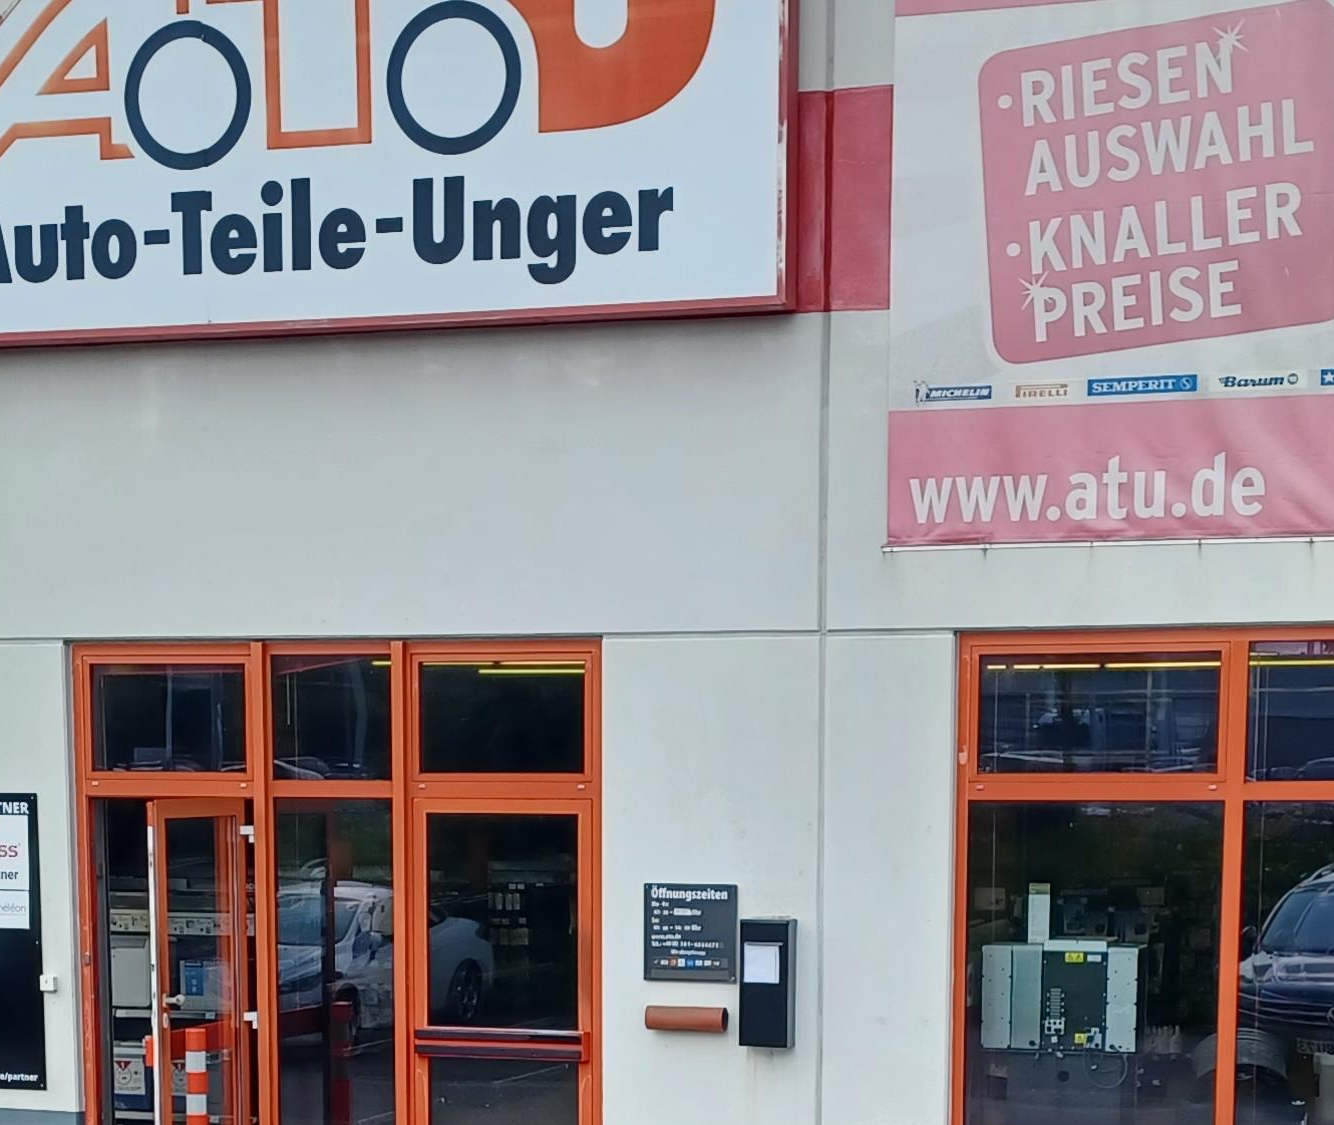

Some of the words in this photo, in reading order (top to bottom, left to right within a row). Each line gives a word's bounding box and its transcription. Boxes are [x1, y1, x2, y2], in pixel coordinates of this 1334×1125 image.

[1019, 41, 1233, 127] RIESEN
[1024, 98, 1315, 196] AUSWAHL
[1028, 182, 1303, 276] KNALLER
[1031, 259, 1243, 343] PREISE
[928, 387, 991, 399] MICHELIN
[1015, 383, 1069, 398] PIRELLI
[1091, 377, 1177, 394] SEMPERIT
[1218, 374, 1286, 388] Barum
[909, 451, 1266, 525] www.atu.de
[650, 884, 729, 902] Öffnungszeiten
